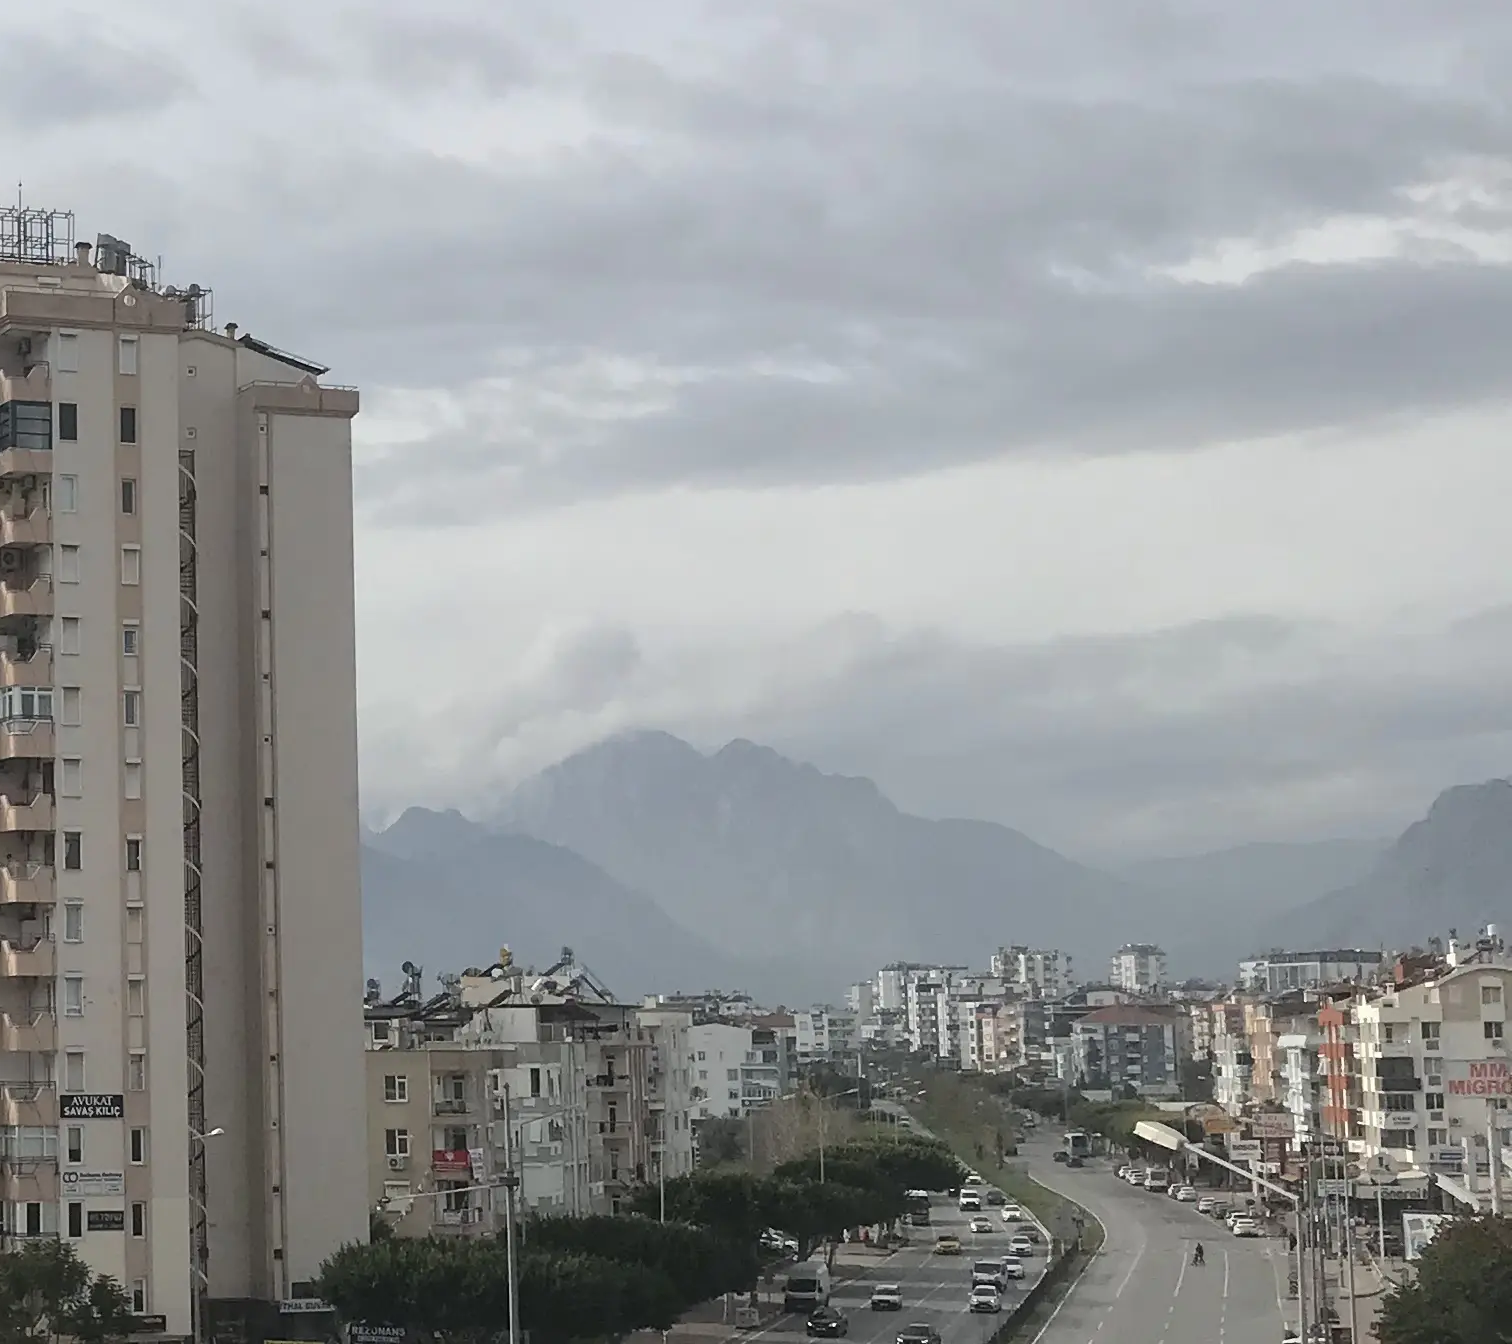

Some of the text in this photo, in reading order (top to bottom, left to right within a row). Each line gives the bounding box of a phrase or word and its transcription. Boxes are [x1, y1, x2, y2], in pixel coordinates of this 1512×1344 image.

[71, 1095, 113, 1106] AVUKAT
[64, 1106, 121, 1117] SAVAŞ KILIÇ
